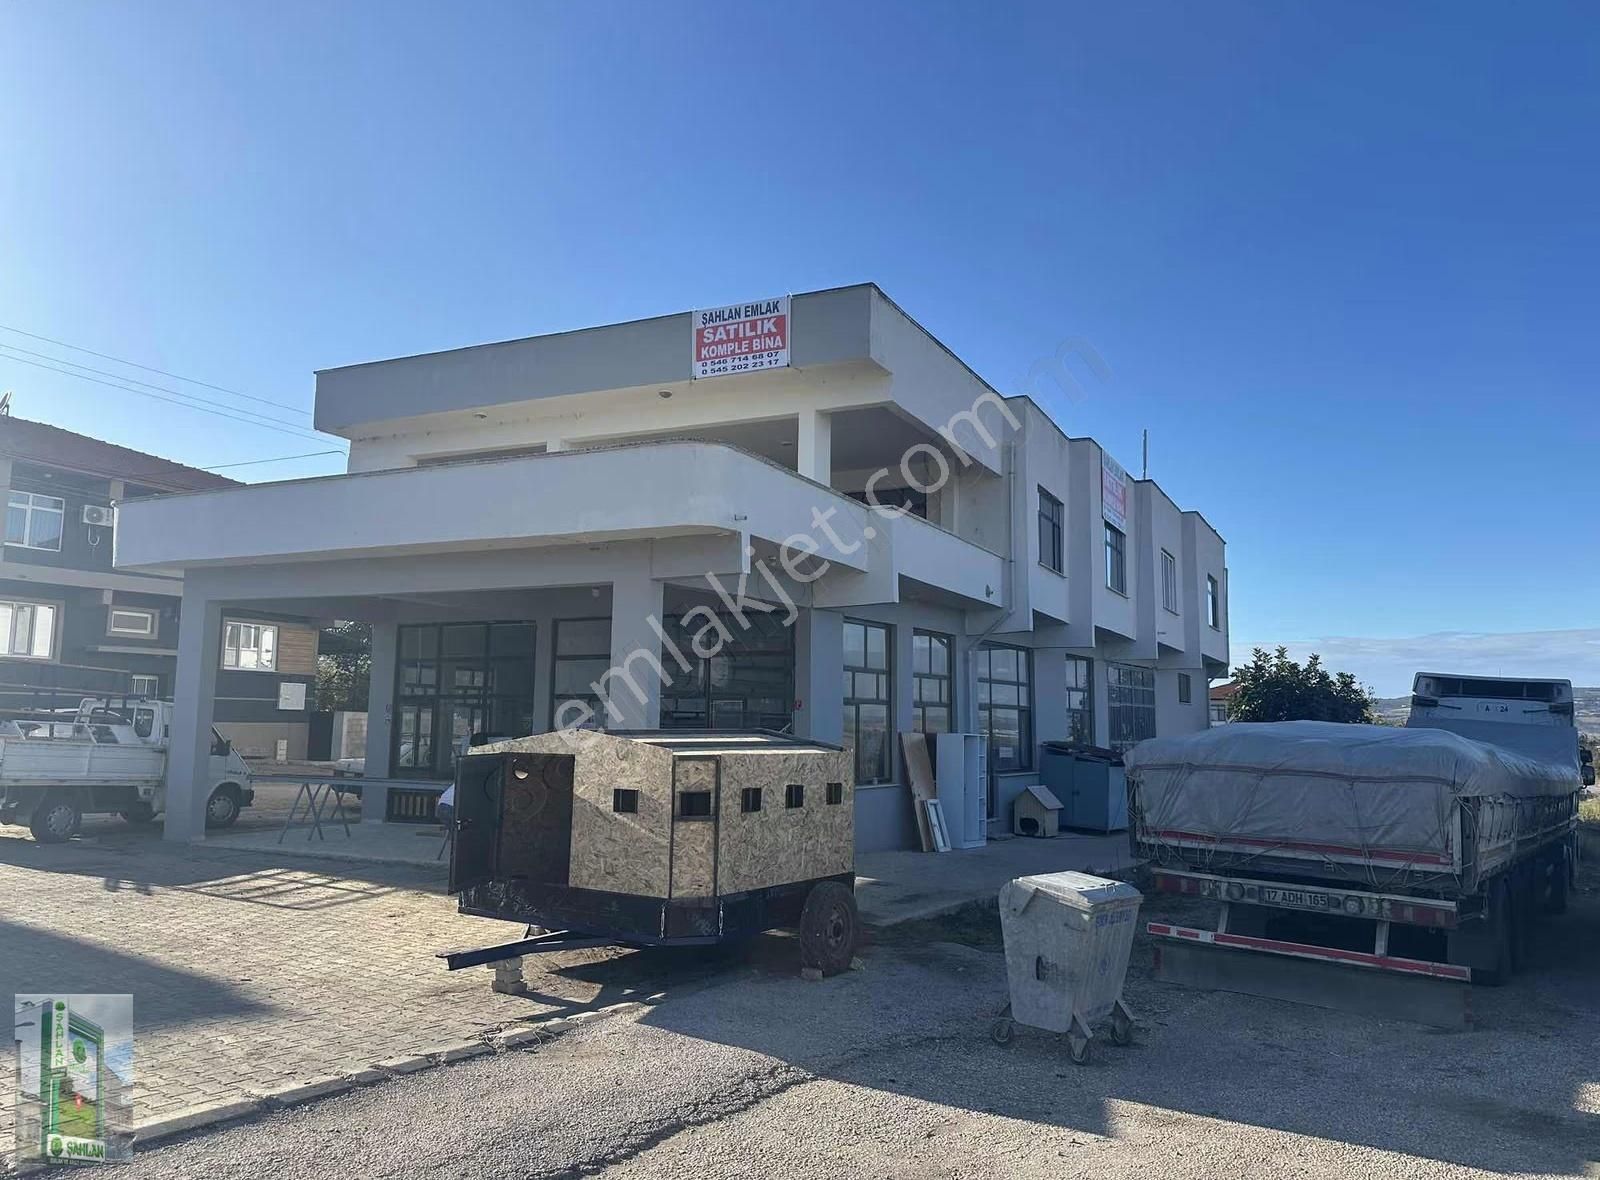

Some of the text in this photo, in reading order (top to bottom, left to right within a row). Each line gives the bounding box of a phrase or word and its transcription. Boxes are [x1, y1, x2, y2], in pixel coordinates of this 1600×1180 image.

[702, 300, 780, 328] ŞAHLAN EMLAK
[703, 318, 777, 343] SATILIK
[701, 335, 783, 359] KOMPLE BİNA
[710, 366, 728, 374] 545
[731, 363, 749, 371] 202
[731, 355, 749, 363] 714
[1267, 890, 1327, 906] 17 ADH 165
